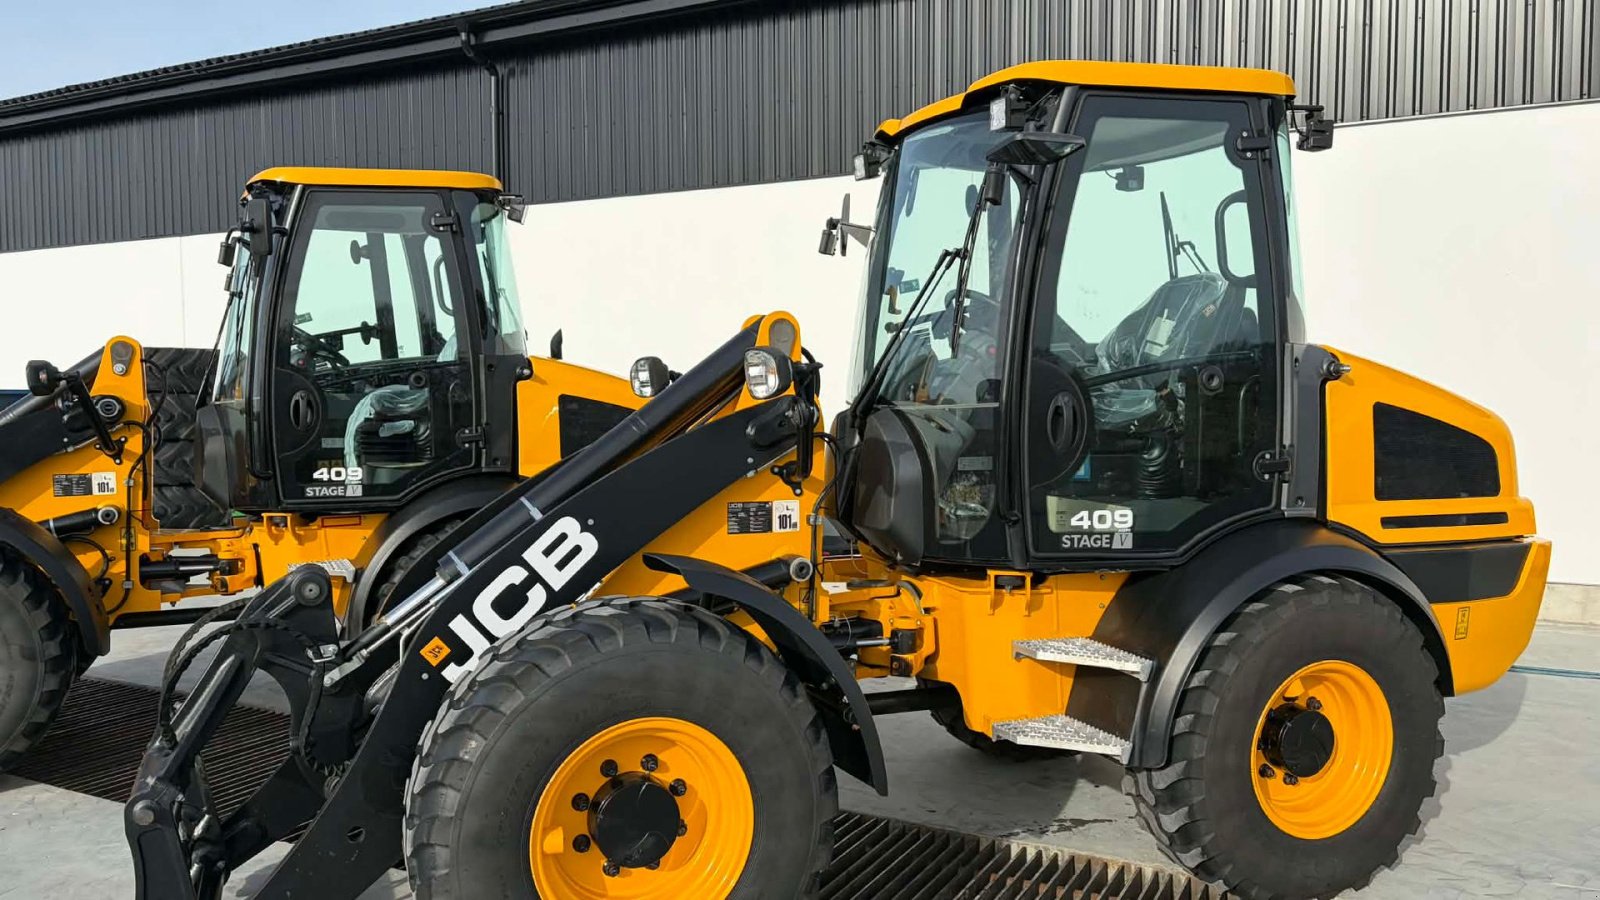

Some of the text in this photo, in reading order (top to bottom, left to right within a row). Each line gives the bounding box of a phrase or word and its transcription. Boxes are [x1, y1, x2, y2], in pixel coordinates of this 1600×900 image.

[312, 467, 363, 481] 409
[97, 482, 110, 493] 101
[305, 486, 345, 497] STAGE
[777, 514, 792, 530] 101
[1071, 509, 1133, 529] 409
[1062, 534, 1111, 548] STAGE
[441, 516, 599, 684] JCB
